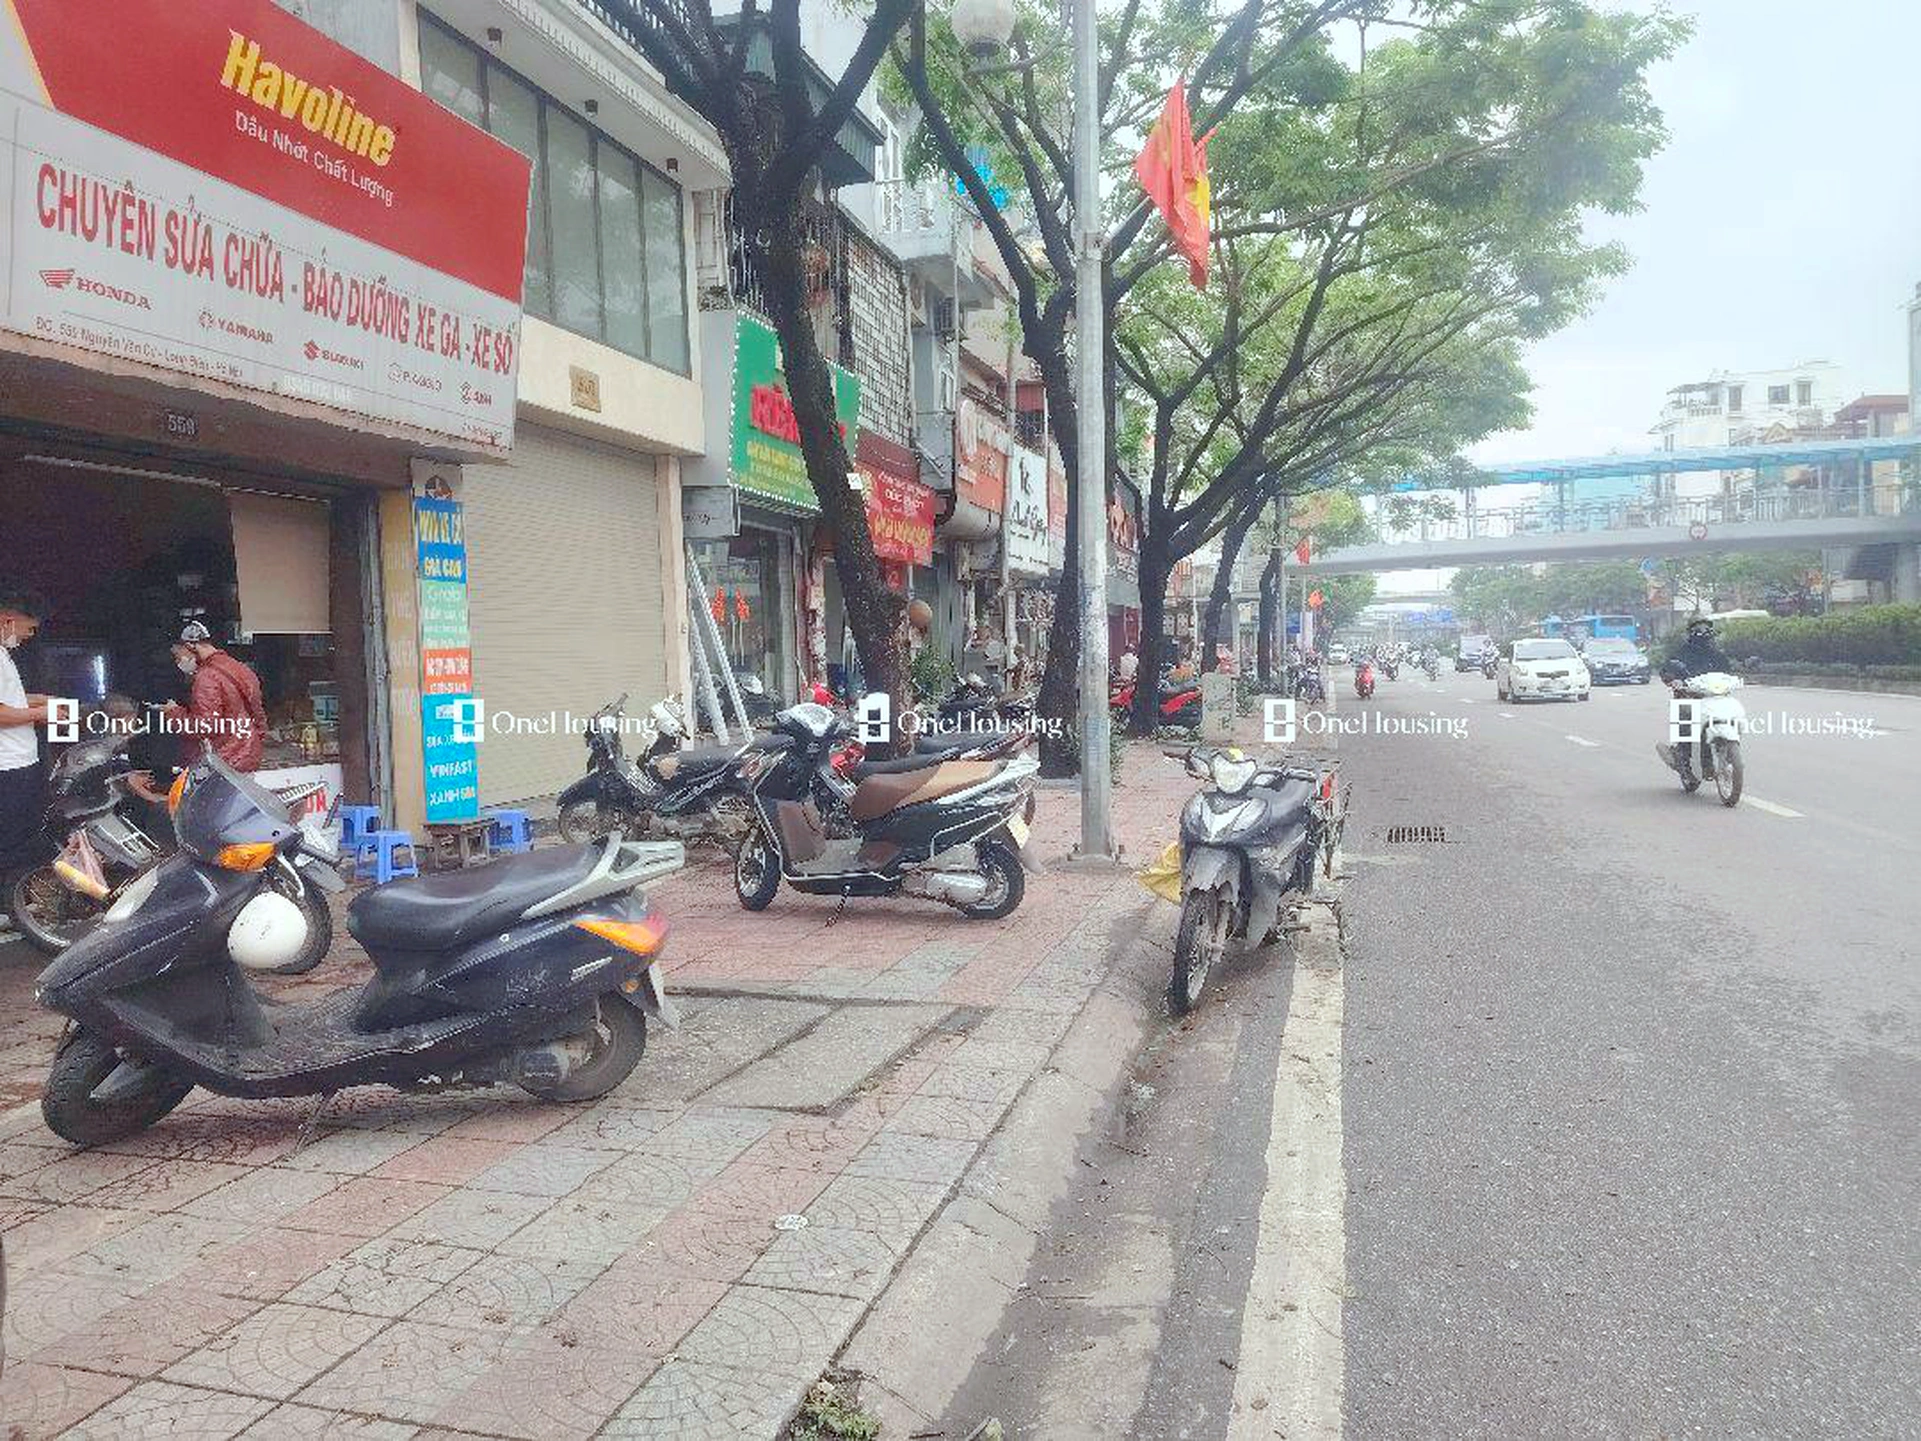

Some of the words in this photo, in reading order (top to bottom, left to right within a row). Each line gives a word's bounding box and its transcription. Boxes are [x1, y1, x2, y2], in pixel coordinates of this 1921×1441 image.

[220, 28, 396, 167] Havoline
[236, 110, 267, 143] Dầu
[273, 129, 308, 163] Nhớt
[314, 150, 348, 182] Chất
[351, 168, 394, 207] Lượng
[37, 162, 155, 261] CHUYÊN
[165, 194, 214, 281] SỬA
[223, 231, 284, 303] CHỮA
[303, 246, 344, 322] BẢO
[347, 273, 410, 344] DƯỠNG
[415, 301, 437, 353] XE
[440, 312, 461, 361] GA
[471, 322, 492, 371] XE
[494, 322, 516, 376] SỐ
[76, 276, 151, 310] HONDA
